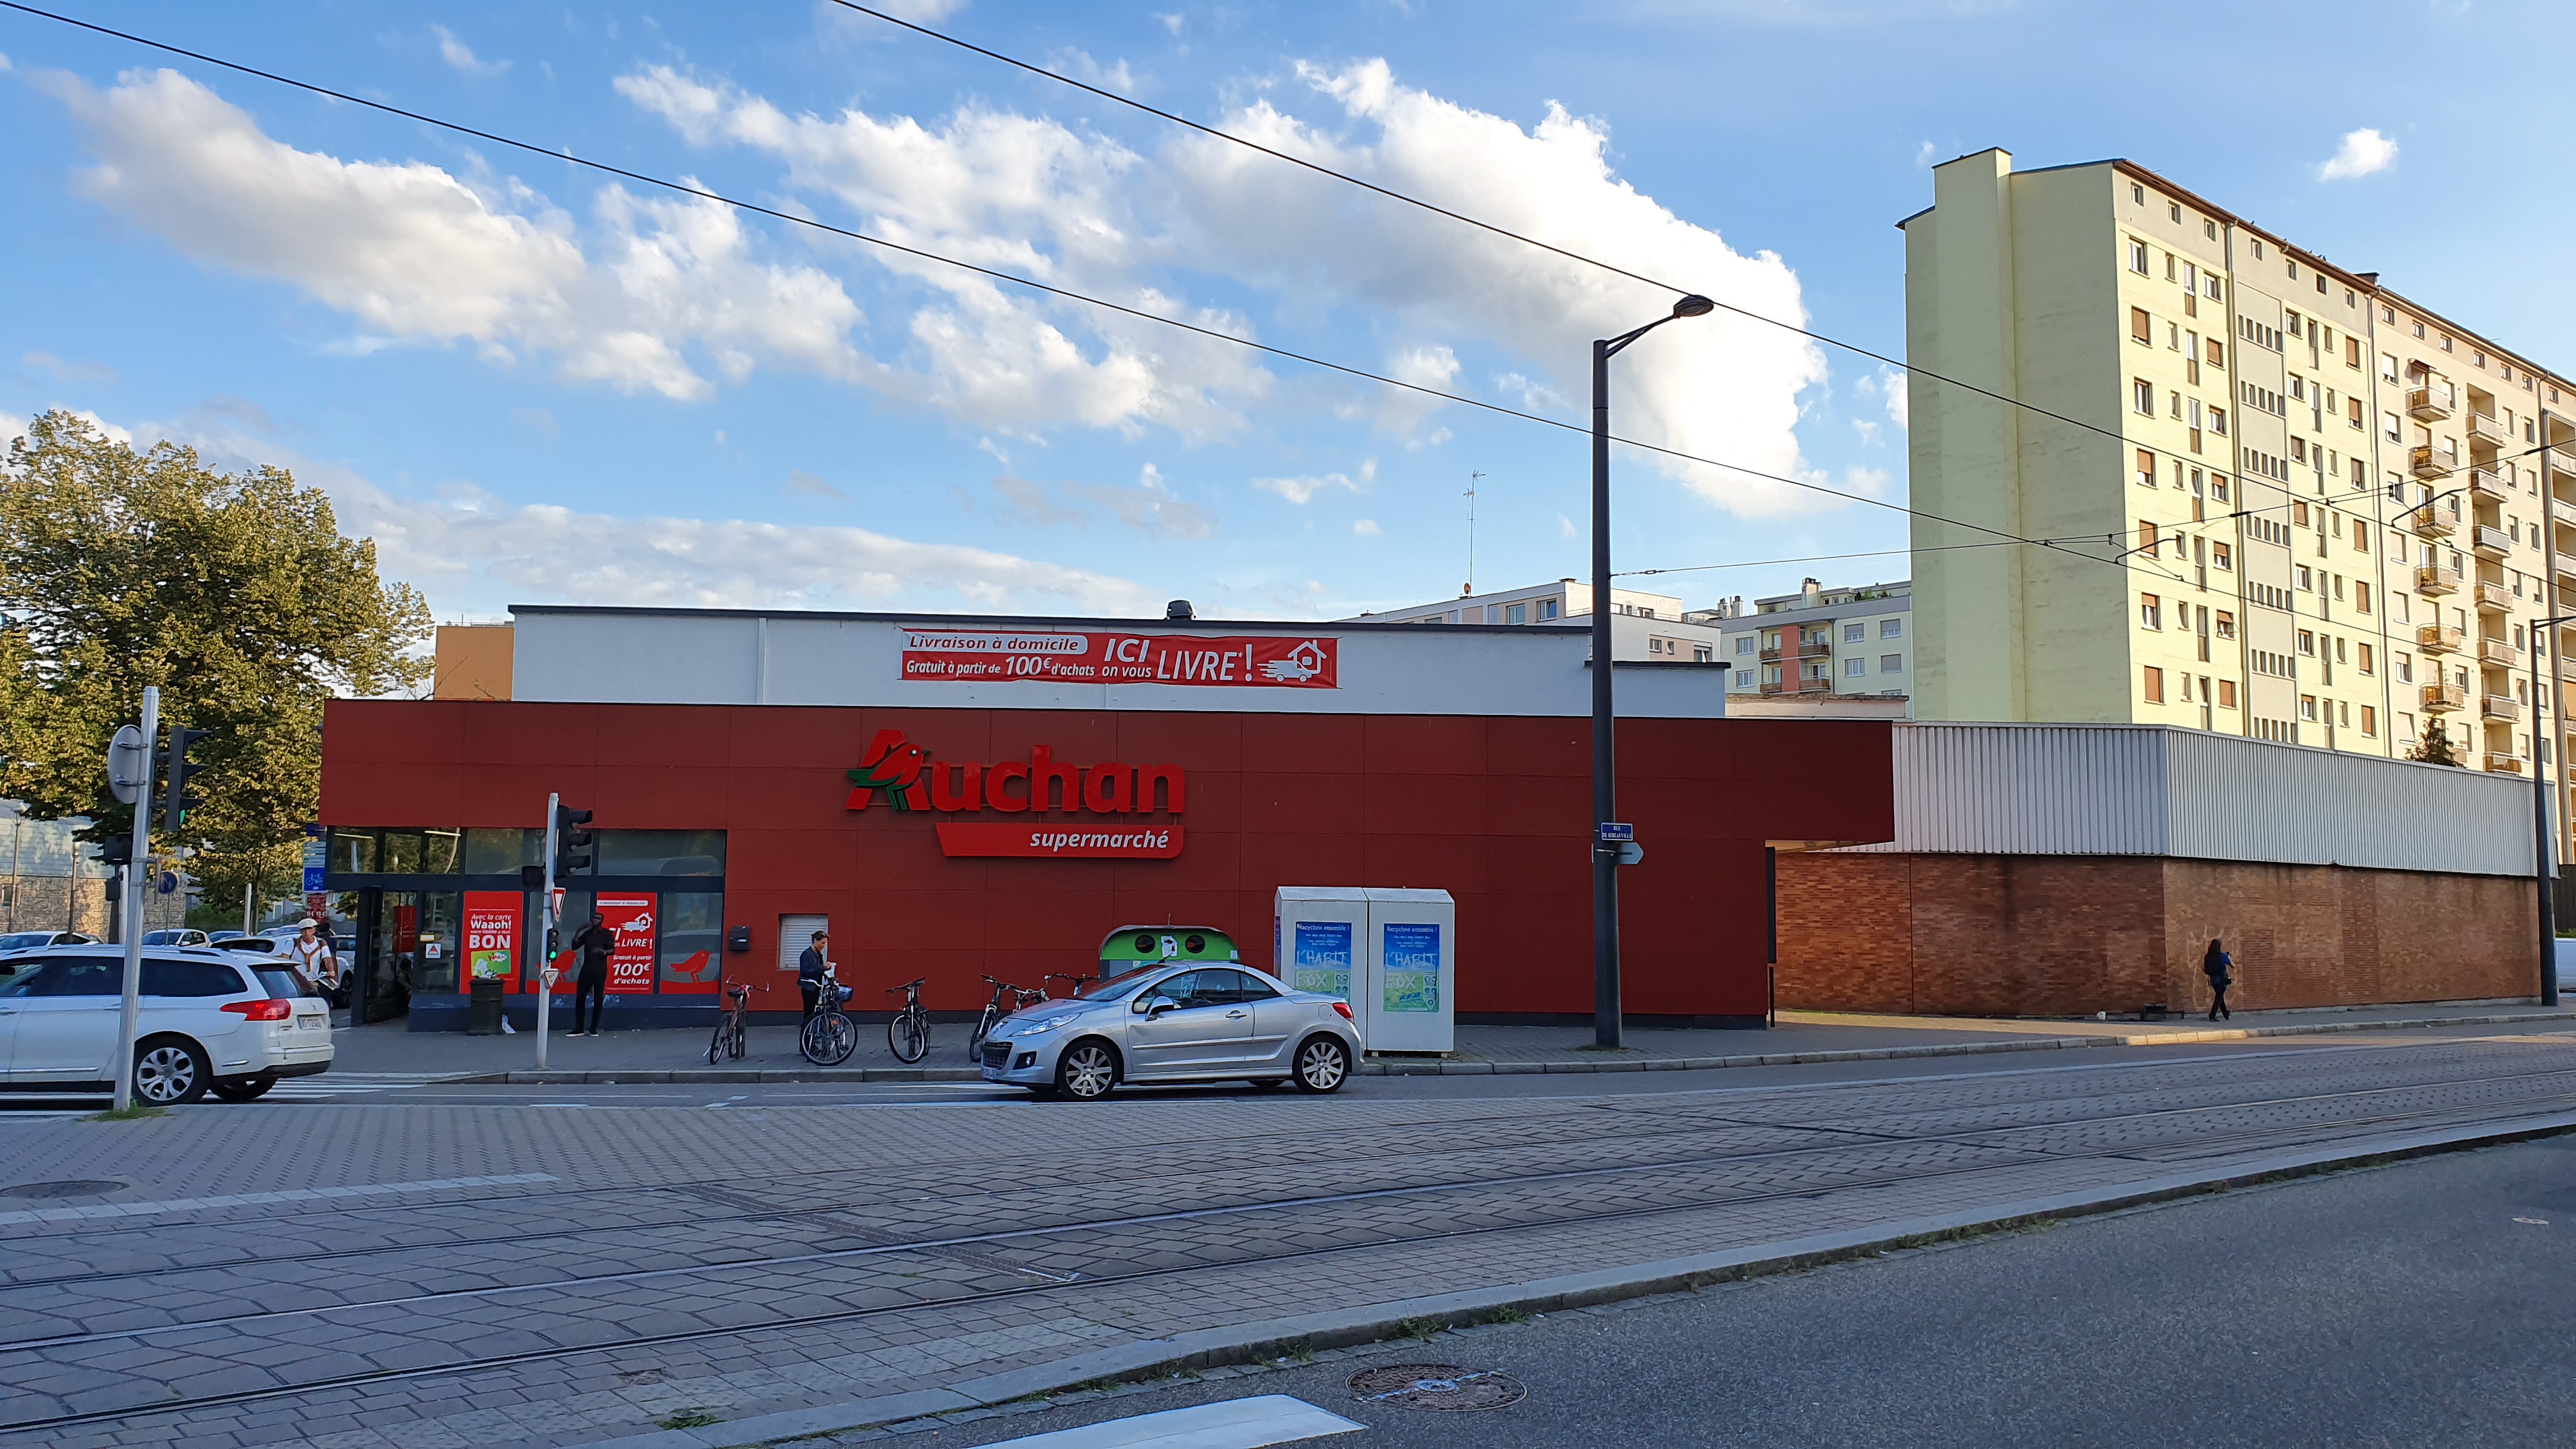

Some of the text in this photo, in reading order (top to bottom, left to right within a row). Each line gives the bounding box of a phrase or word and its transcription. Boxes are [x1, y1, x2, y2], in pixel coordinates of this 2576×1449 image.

[909, 635, 1078, 650] Livraison à domicile
[1104, 639, 1150, 663] ICI
[907, 656, 1095, 677] Gratuit à partir de 100€ d'achats
[1102, 666, 1118, 677] on
[1121, 666, 1151, 677] vous
[845, 729, 1184, 813] Auchan
[1031, 830, 1169, 851] supermarché
[470, 920, 511, 929] Waaoh!
[469, 935, 510, 949] BON
[613, 963, 651, 976] 100€
